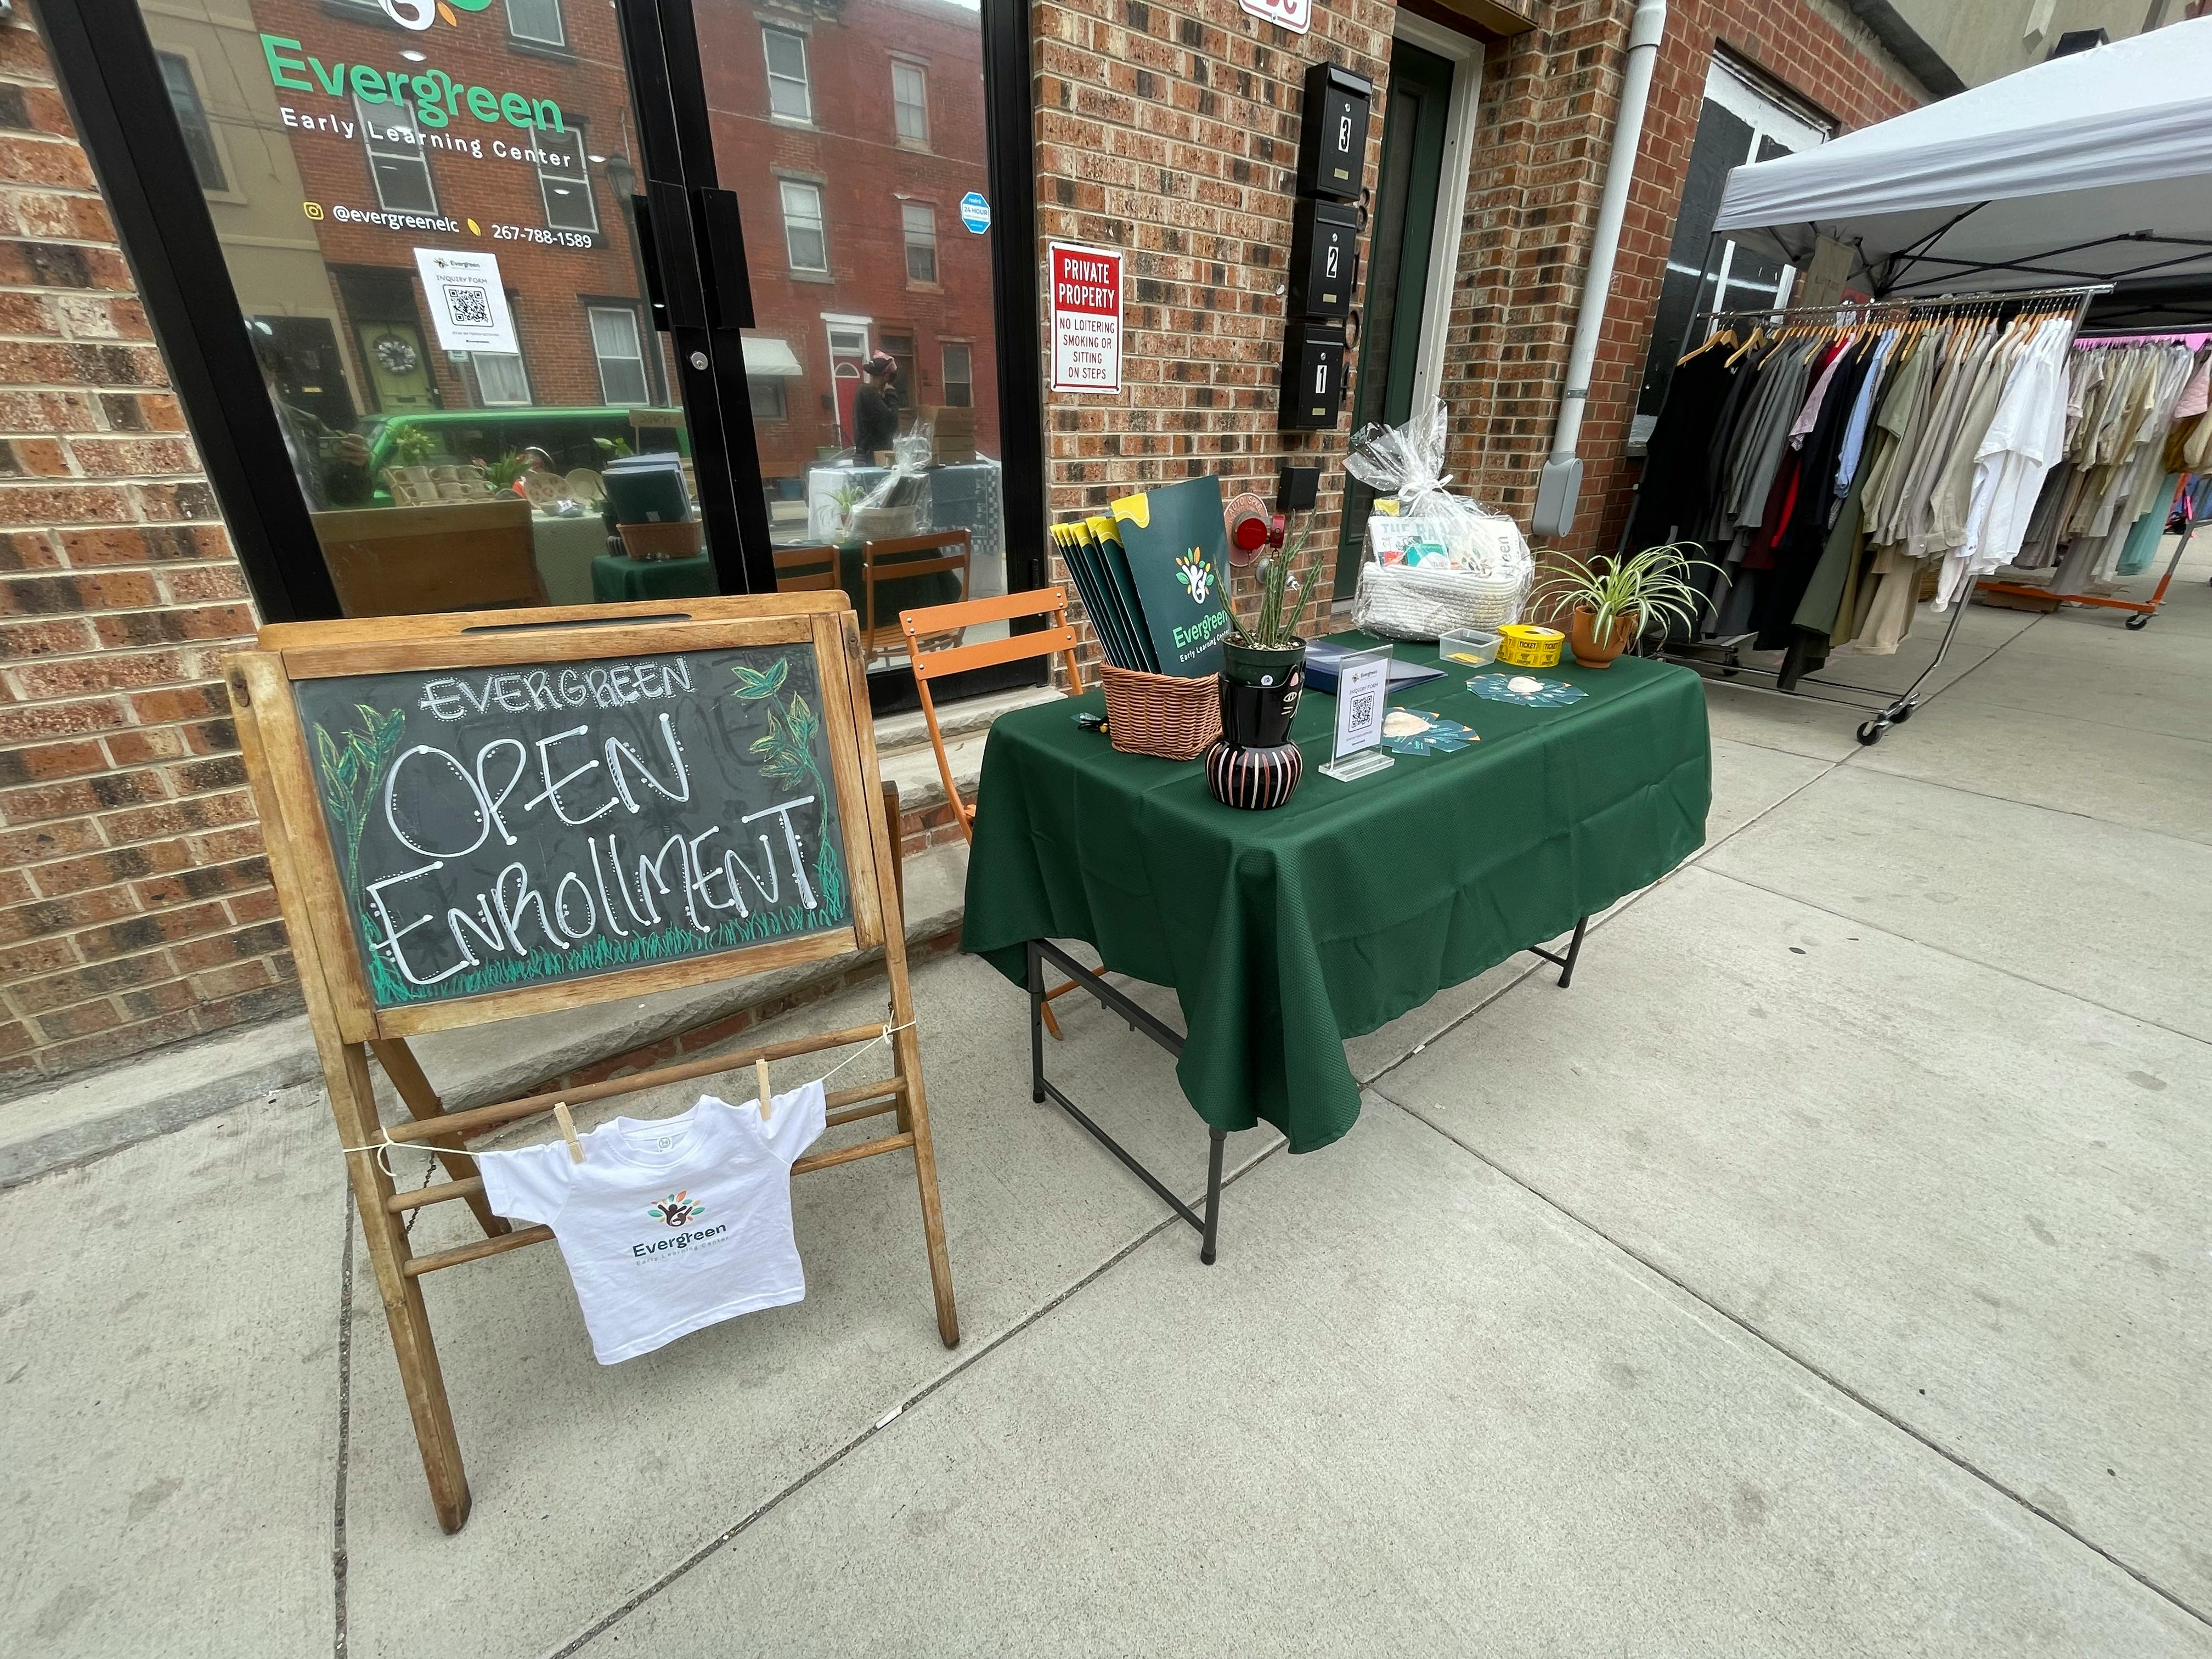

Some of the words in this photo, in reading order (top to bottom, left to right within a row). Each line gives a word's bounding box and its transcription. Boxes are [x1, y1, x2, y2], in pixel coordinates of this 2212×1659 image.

[259, 33, 564, 133] Evergreen
[280, 107, 354, 139] Early
[368, 121, 483, 159] Learning
[493, 140, 571, 167] Center
[1341, 119, 1348, 150] 3
[333, 205, 460, 233] @evergreenelc
[492, 224, 591, 249] 267-788-1589
[450, 260, 481, 268] Evergreen
[1064, 258, 1110, 284] PRIVATE
[1328, 248, 1338, 276] 2
[1059, 283, 1115, 309] PROPERTY
[1060, 318, 1071, 329] NO
[1074, 319, 1115, 334] LOITERING
[1063, 334, 1099, 348] SMOKING
[1101, 337, 1111, 349] OR
[1073, 351, 1102, 364] SITTING
[1068, 366, 1079, 379] ON
[1082, 368, 1106, 380] STEPS
[1229, 497, 1244, 516] AUTO
[1172, 610, 1228, 648] Evergreen
[1179, 650, 1195, 663] Early
[1196, 637, 1216, 653] Learning
[1519, 641, 1537, 649] TICKET
[418, 655, 698, 722] EVERGREEN
[384, 712, 690, 858] OPEN
[633, 1224, 726, 1257] Evergreen
[636, 1256, 658, 1266] Early
[662, 1246, 698, 1259] Learning
[702, 1237, 729, 1248] Center
